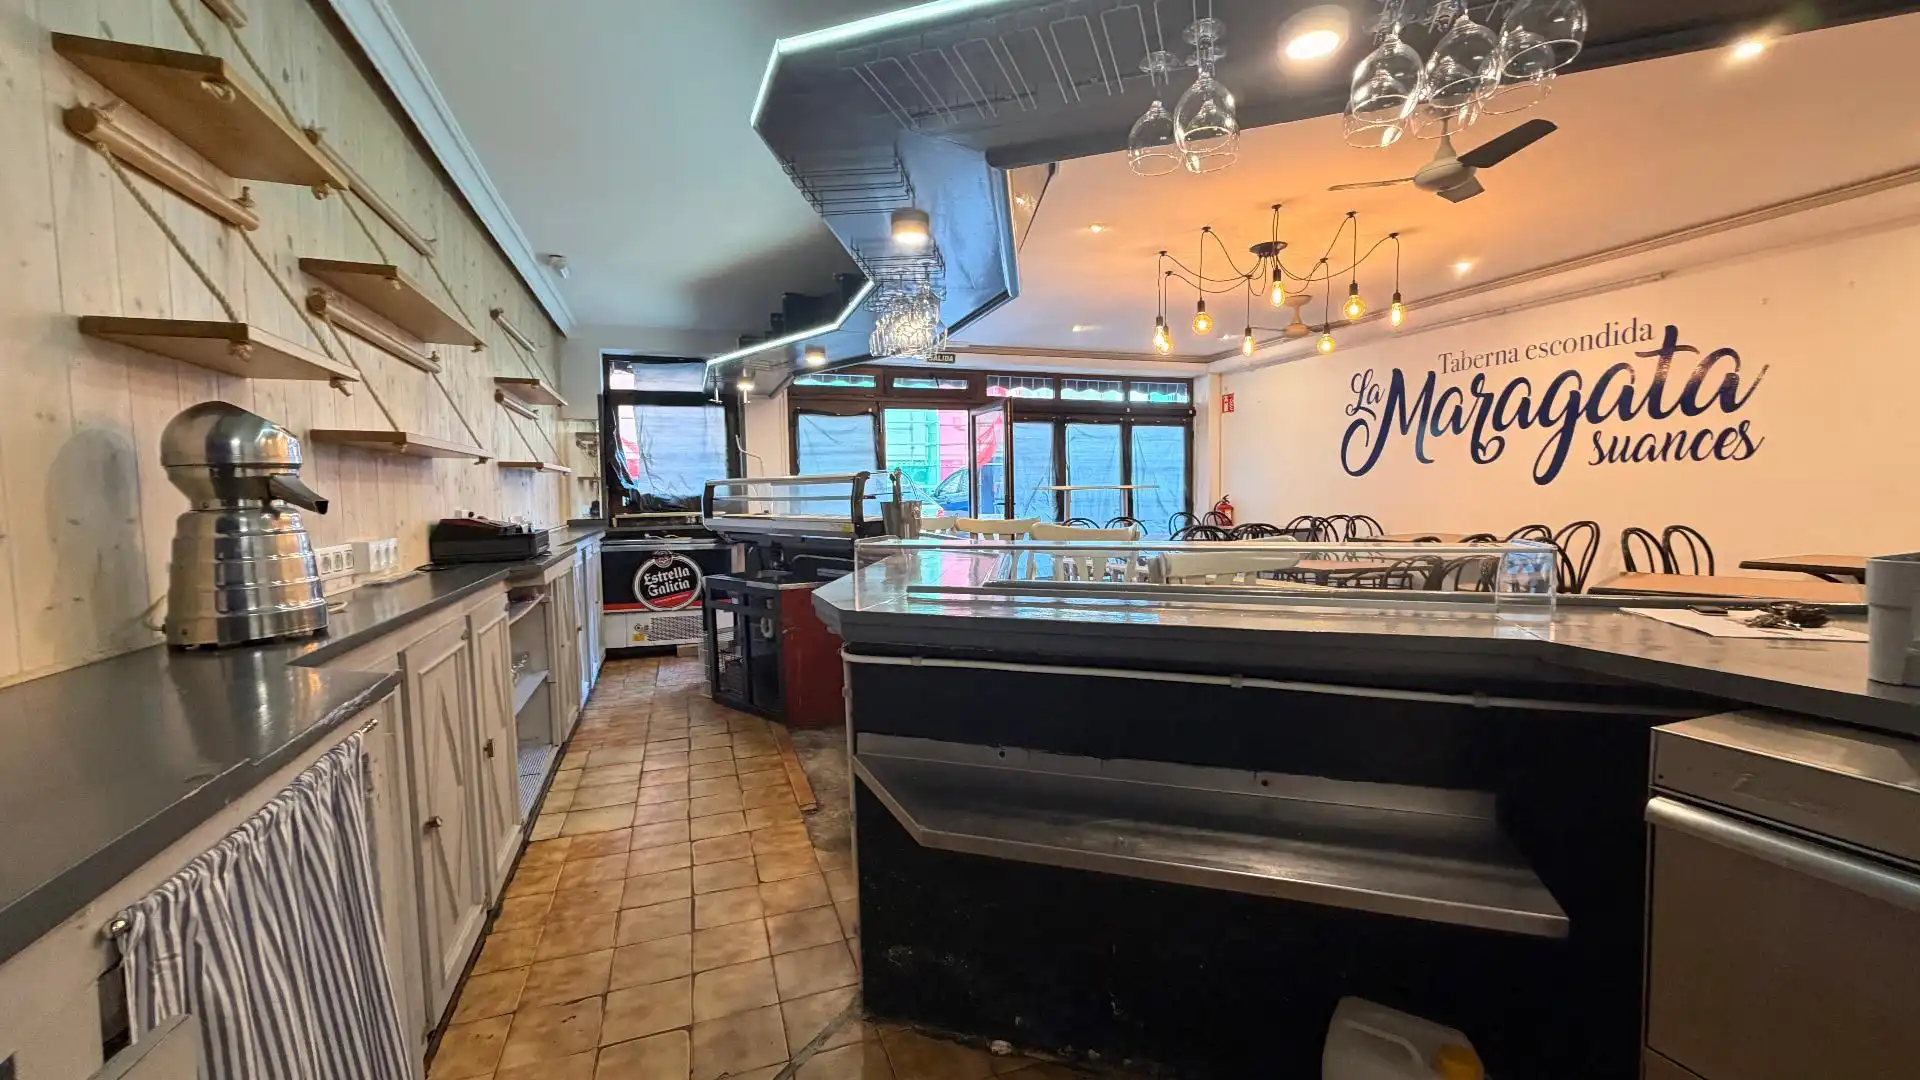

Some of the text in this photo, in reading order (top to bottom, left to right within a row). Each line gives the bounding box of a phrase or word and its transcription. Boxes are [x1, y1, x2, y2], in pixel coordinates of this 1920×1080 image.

[1438, 317, 1655, 375] Taberna escondida
[1340, 324, 1770, 486] La Maragata
[1588, 419, 1765, 466] suances
[643, 567, 691, 586] Estrella
[647, 578, 691, 597] Galicia
